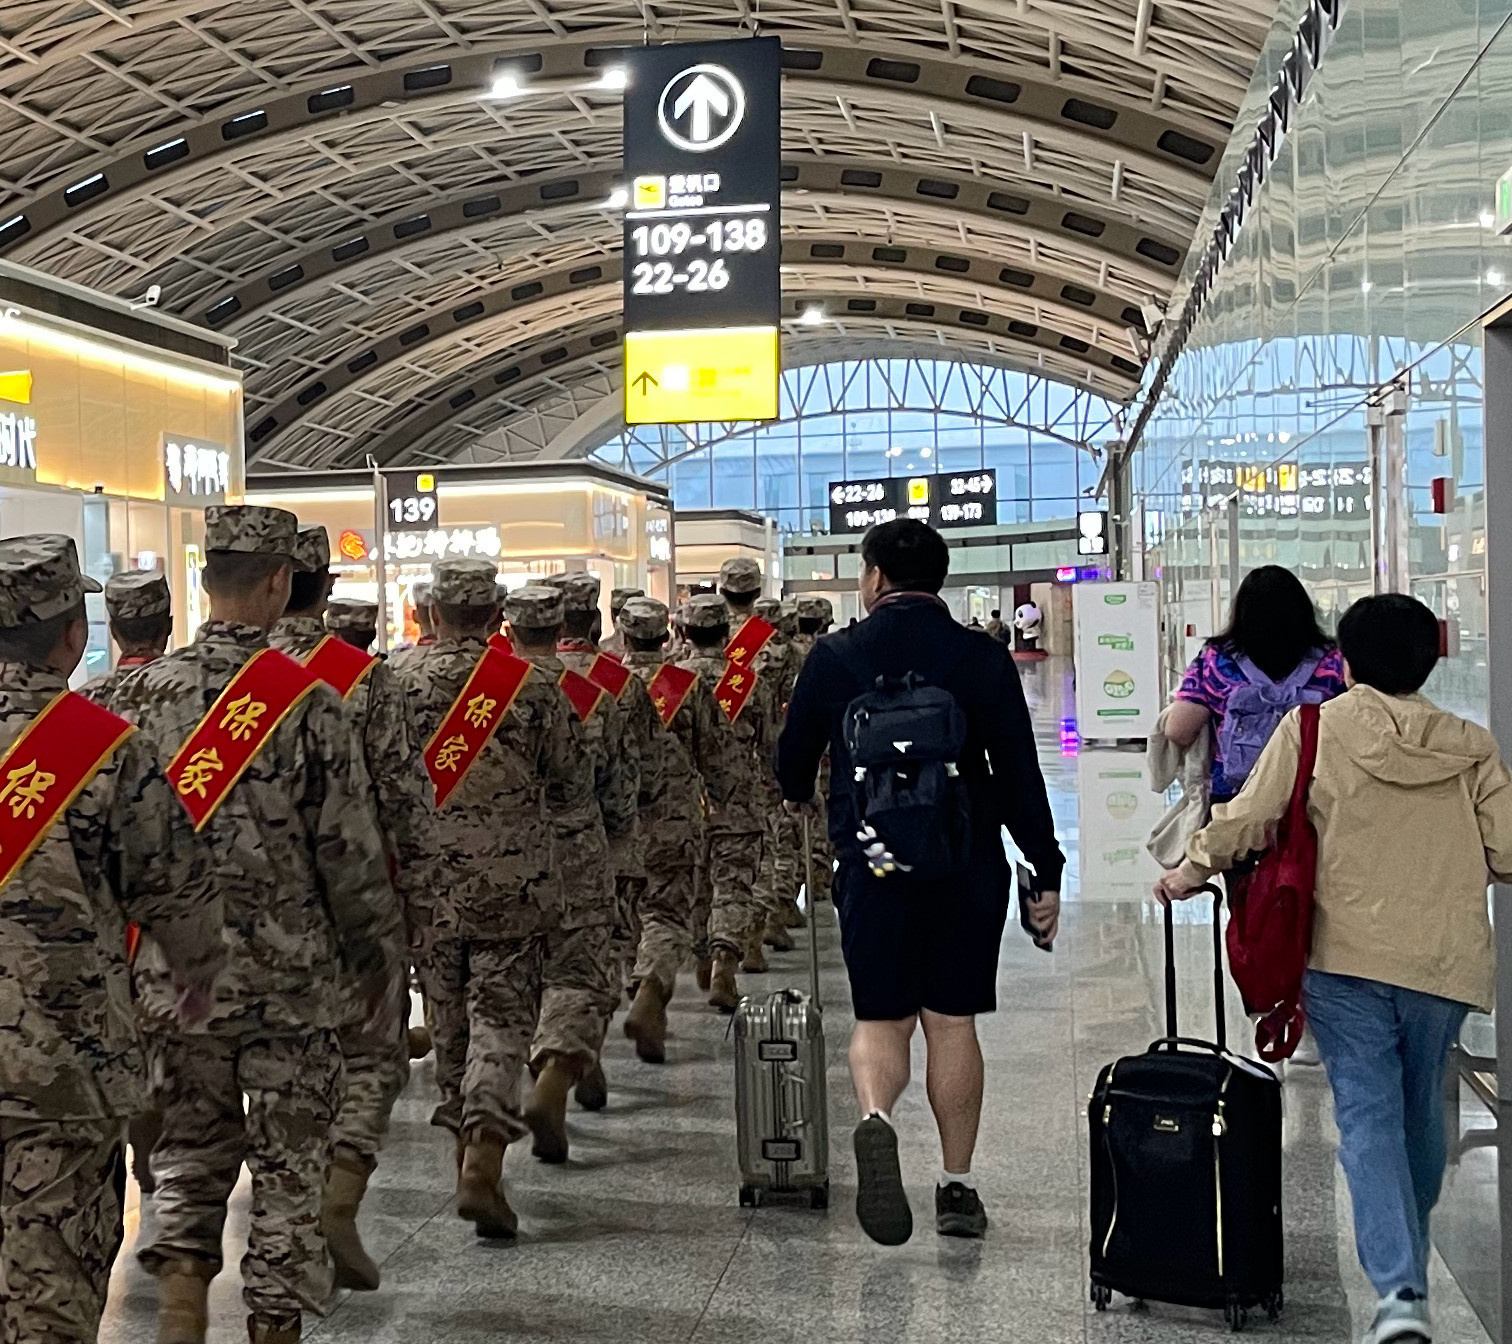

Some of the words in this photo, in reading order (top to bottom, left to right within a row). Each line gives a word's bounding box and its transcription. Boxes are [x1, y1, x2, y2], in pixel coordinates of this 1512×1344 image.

[633, 218, 766, 256] 109-138
[633, 258, 729, 293] 22-26
[389, 496, 436, 522] 139
[178, 692, 266, 798] 保家
[433, 693, 496, 794] 保家
